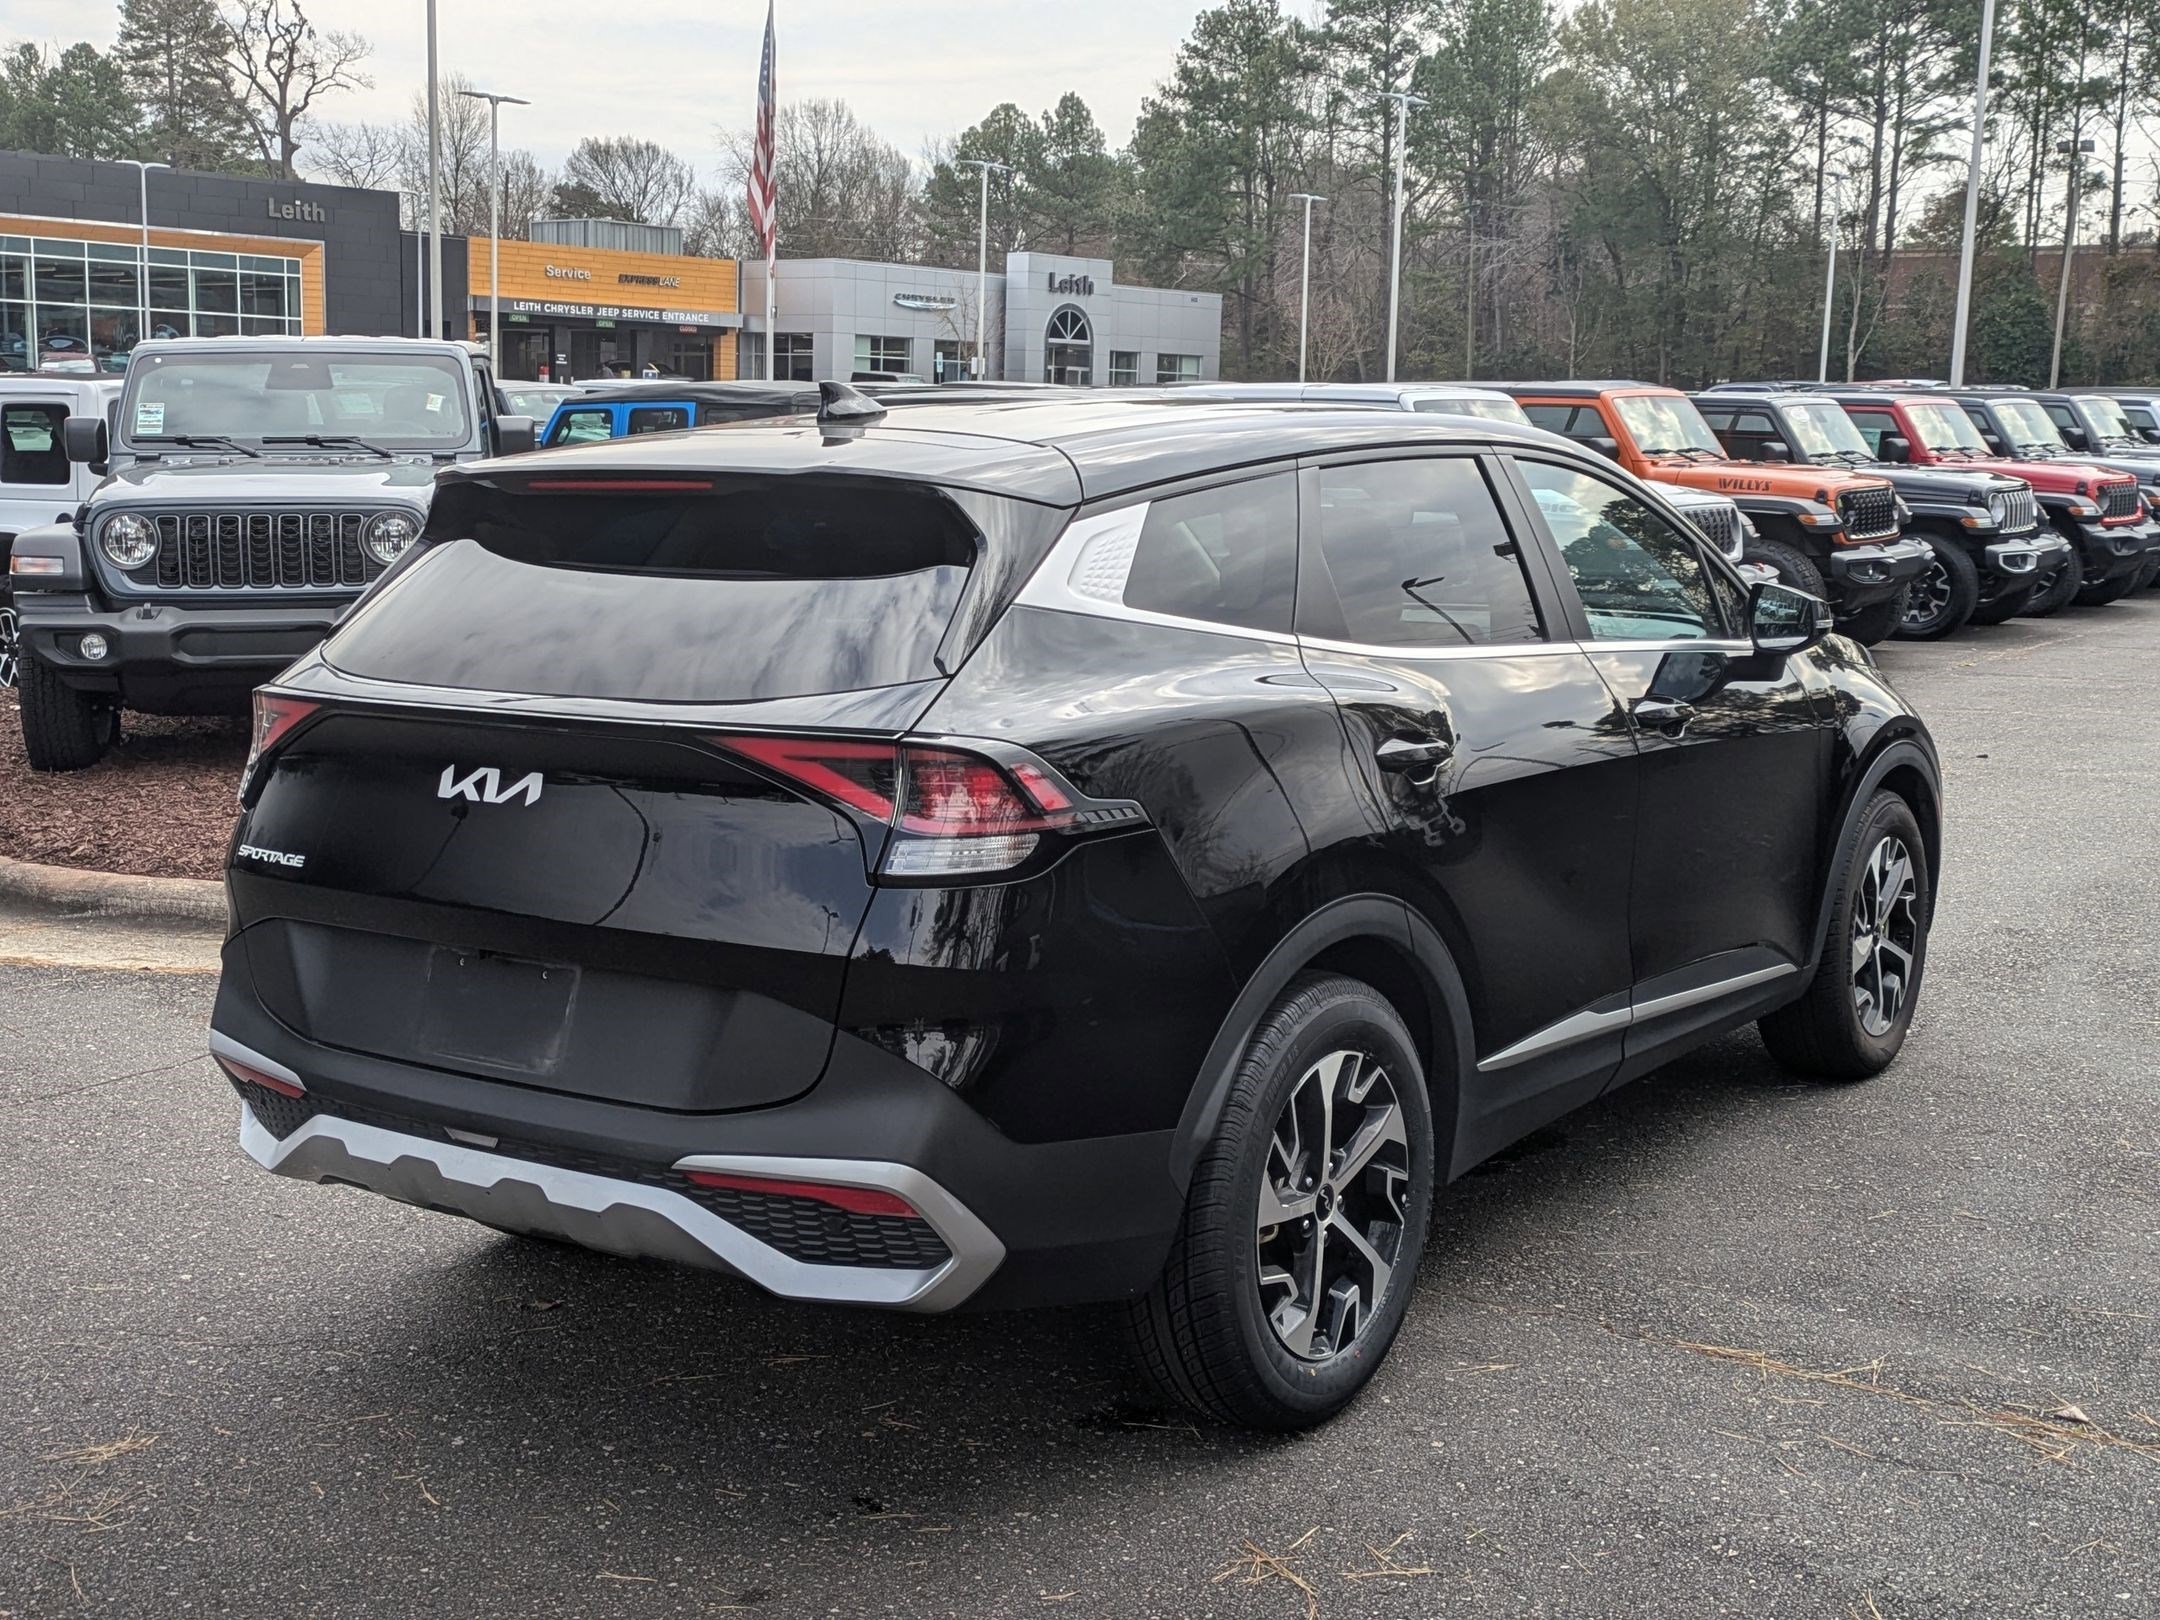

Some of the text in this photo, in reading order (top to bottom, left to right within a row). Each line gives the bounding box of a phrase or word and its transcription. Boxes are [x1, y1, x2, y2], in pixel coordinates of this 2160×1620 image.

[268, 197, 326, 222] Leith
[545, 264, 592, 280] Service
[1048, 272, 1095, 296] Leith
[513, 301, 710, 322] LEITH CHRYSLER JEEP SERVICE ENTRANCE
[1718, 478, 1773, 492] WILLYS
[437, 763, 545, 807] KIA
[238, 844, 305, 868] SPORTAGE
